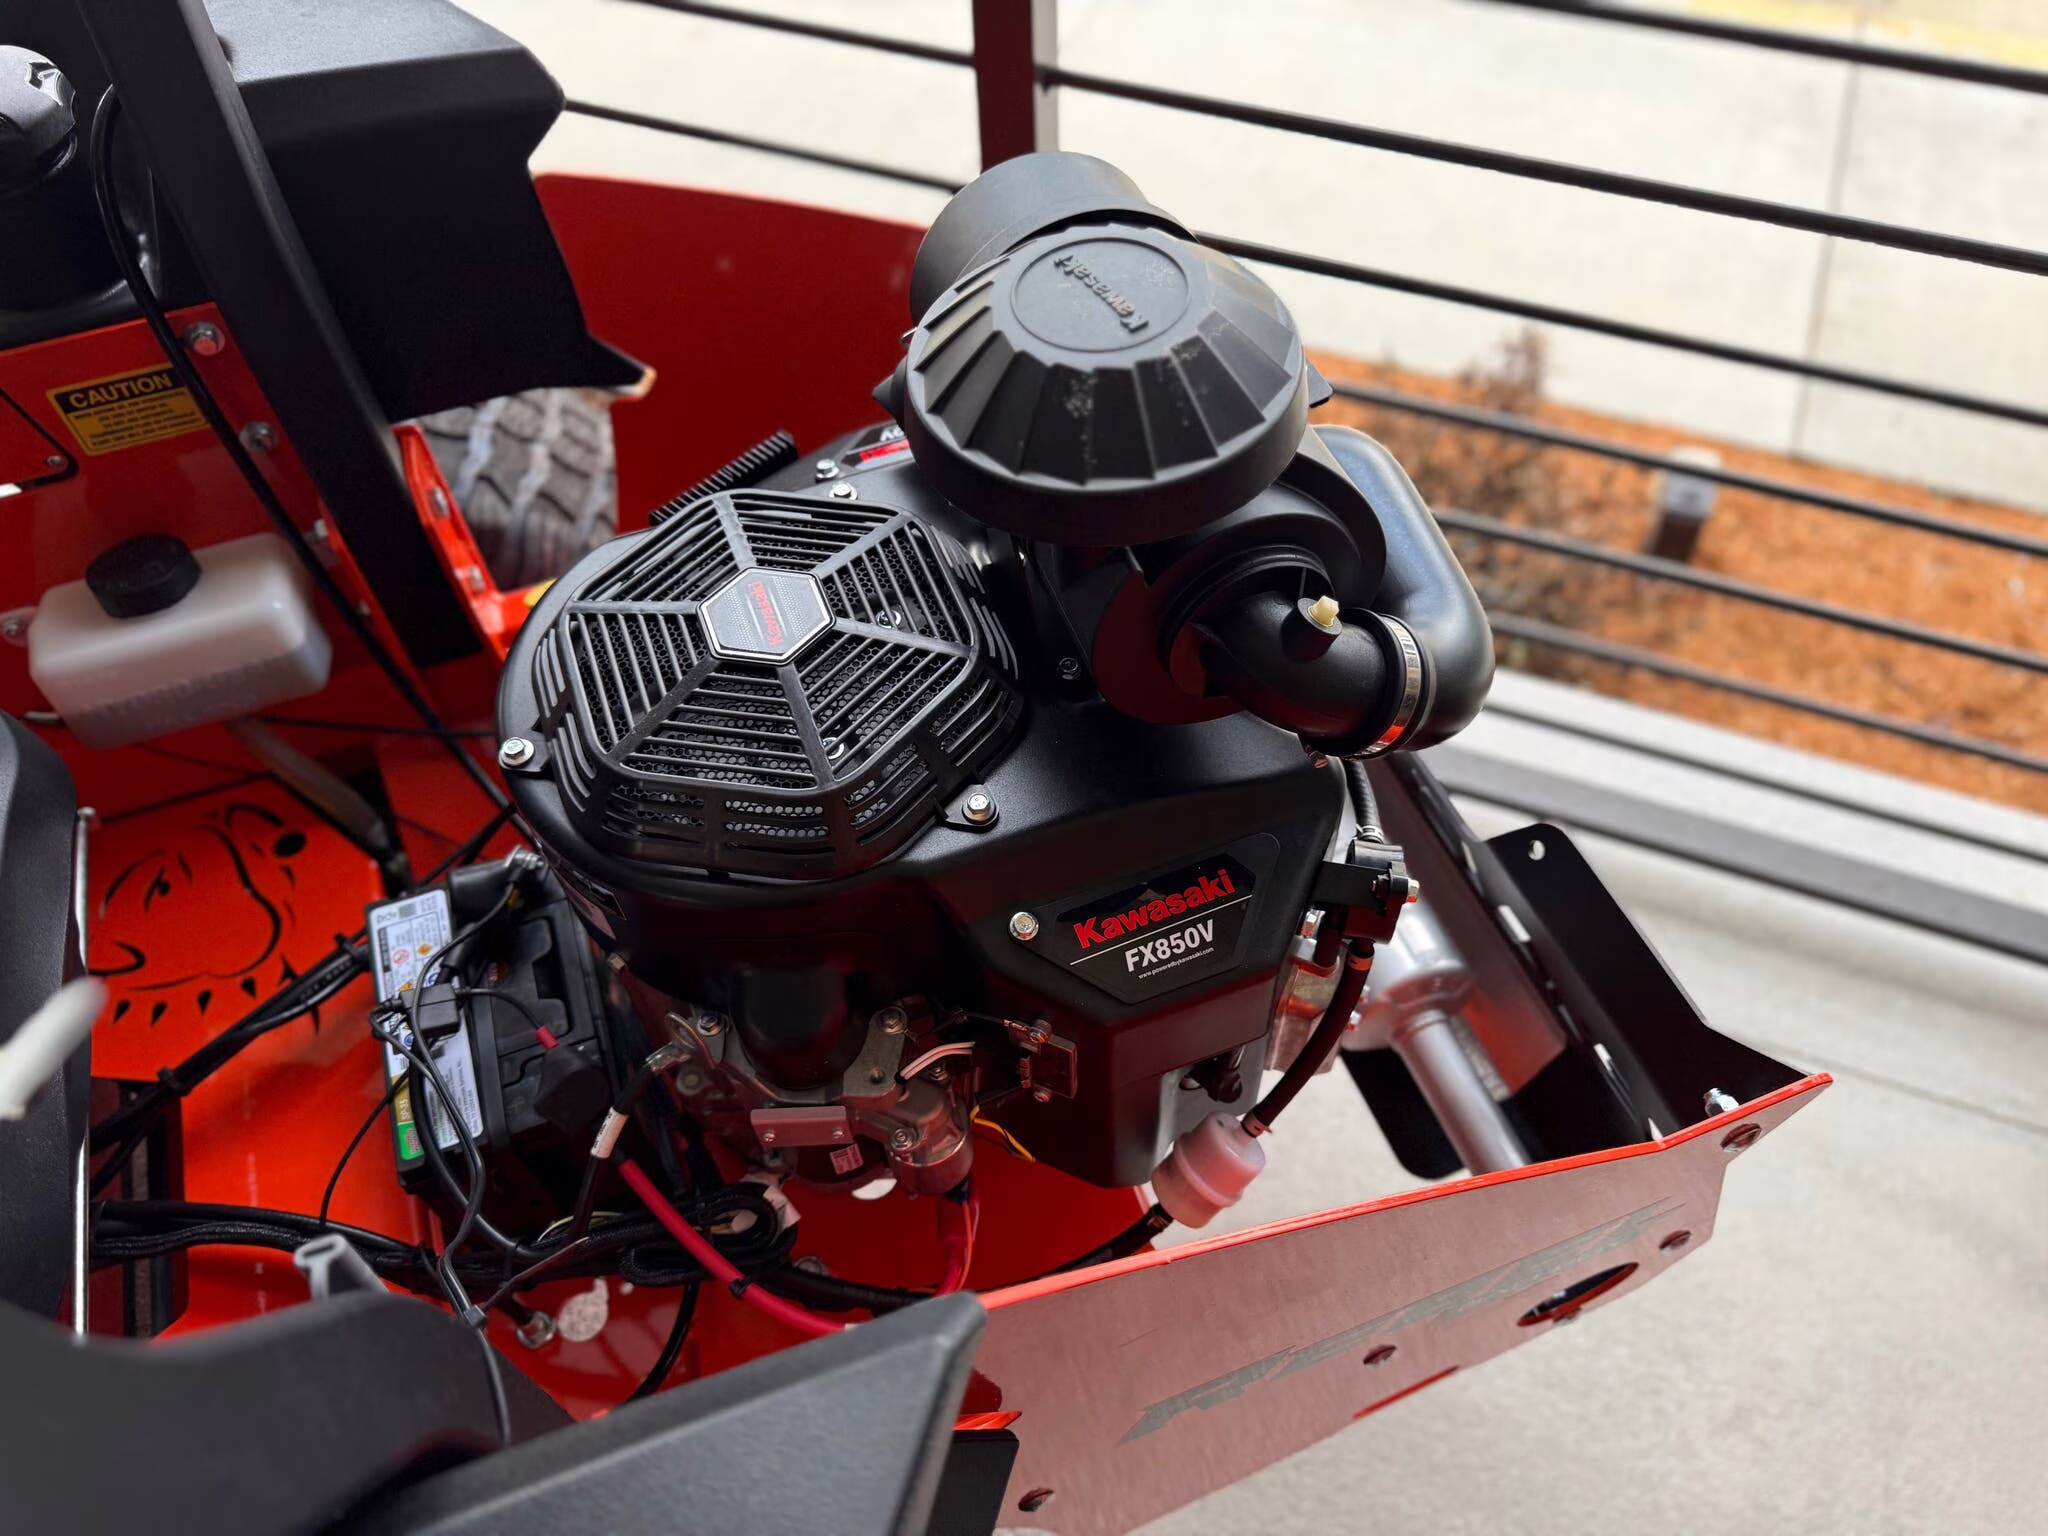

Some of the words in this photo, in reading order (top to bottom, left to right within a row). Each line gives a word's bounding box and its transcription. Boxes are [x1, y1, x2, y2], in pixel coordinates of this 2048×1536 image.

[1054, 254, 1149, 333] Kawasaki
[69, 373, 173, 408] CAUTION
[1073, 869, 1236, 949] Kawasaki
[1124, 918, 1214, 973] FX850V
